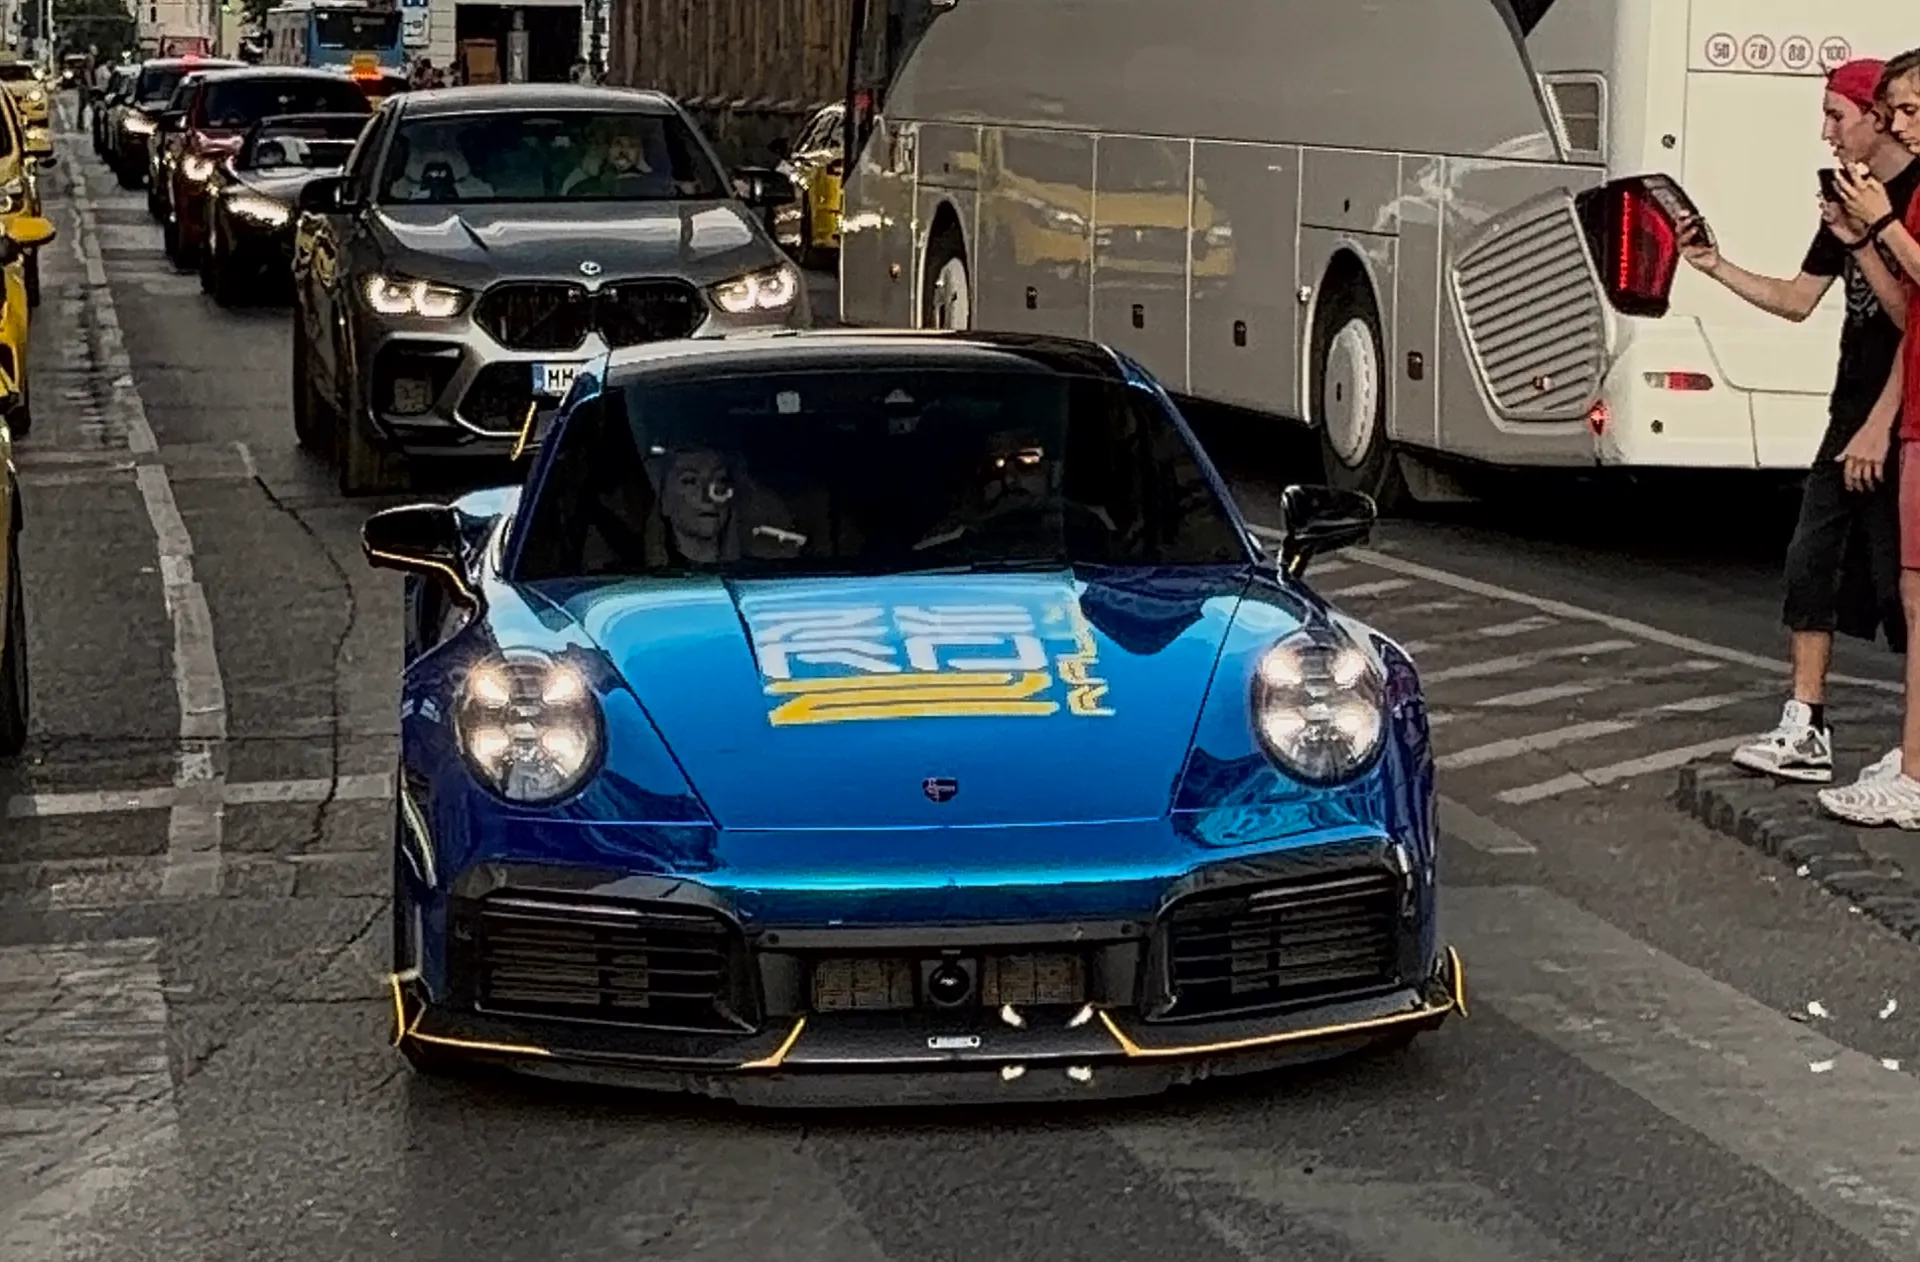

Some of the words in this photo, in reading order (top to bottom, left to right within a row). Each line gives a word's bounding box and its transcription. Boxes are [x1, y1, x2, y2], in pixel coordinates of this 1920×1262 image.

[1713, 42, 1730, 59] 50
[1750, 44, 1768, 60] 70
[1788, 44, 1806, 61] 80
[1825, 45, 1846, 61] 100
